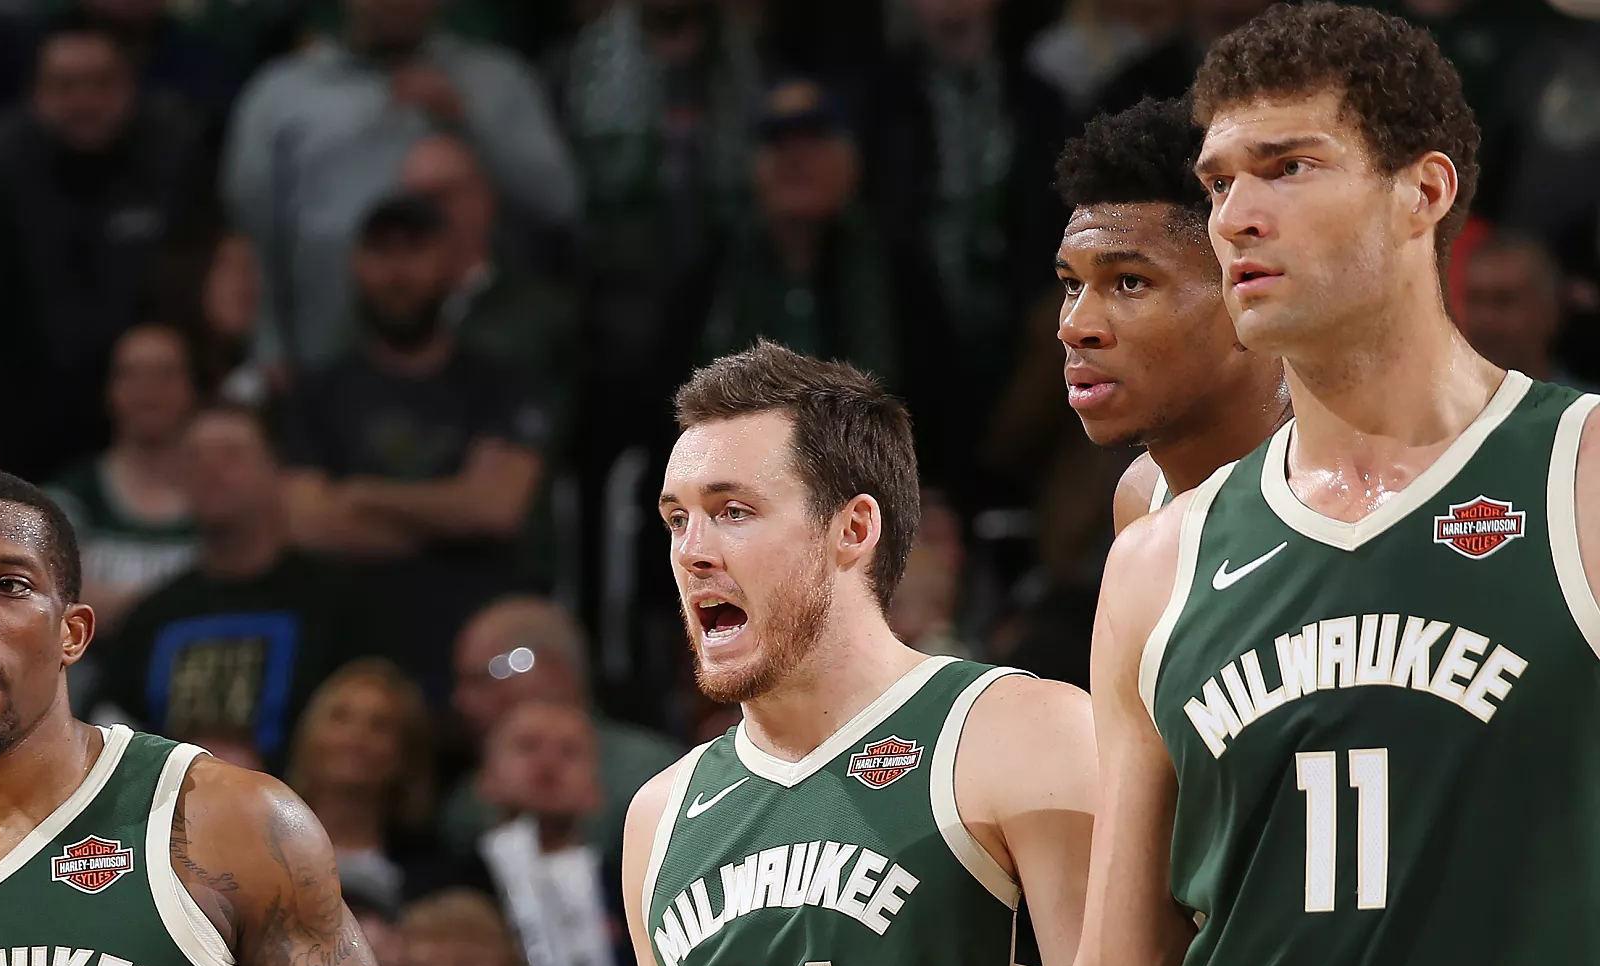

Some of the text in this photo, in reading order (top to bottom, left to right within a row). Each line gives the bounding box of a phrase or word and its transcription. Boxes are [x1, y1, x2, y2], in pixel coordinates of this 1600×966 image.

[1460, 504, 1500, 518] MOTOR
[1442, 519, 1517, 536] HARLEY-DAVIDSON
[1459, 534, 1499, 551] CYCLES
[1183, 613, 1529, 760] MILWAUKEE
[872, 743, 907, 755] MOTOR
[855, 754, 917, 770] HARLEY-DAVIDSON
[866, 769, 899, 783] CYCLES
[1294, 747, 1389, 913] 11
[74, 843, 111, 857] MOTOR
[59, 855, 127, 874] HARLEY-DAVIDSON
[75, 871, 112, 887] CYCLES
